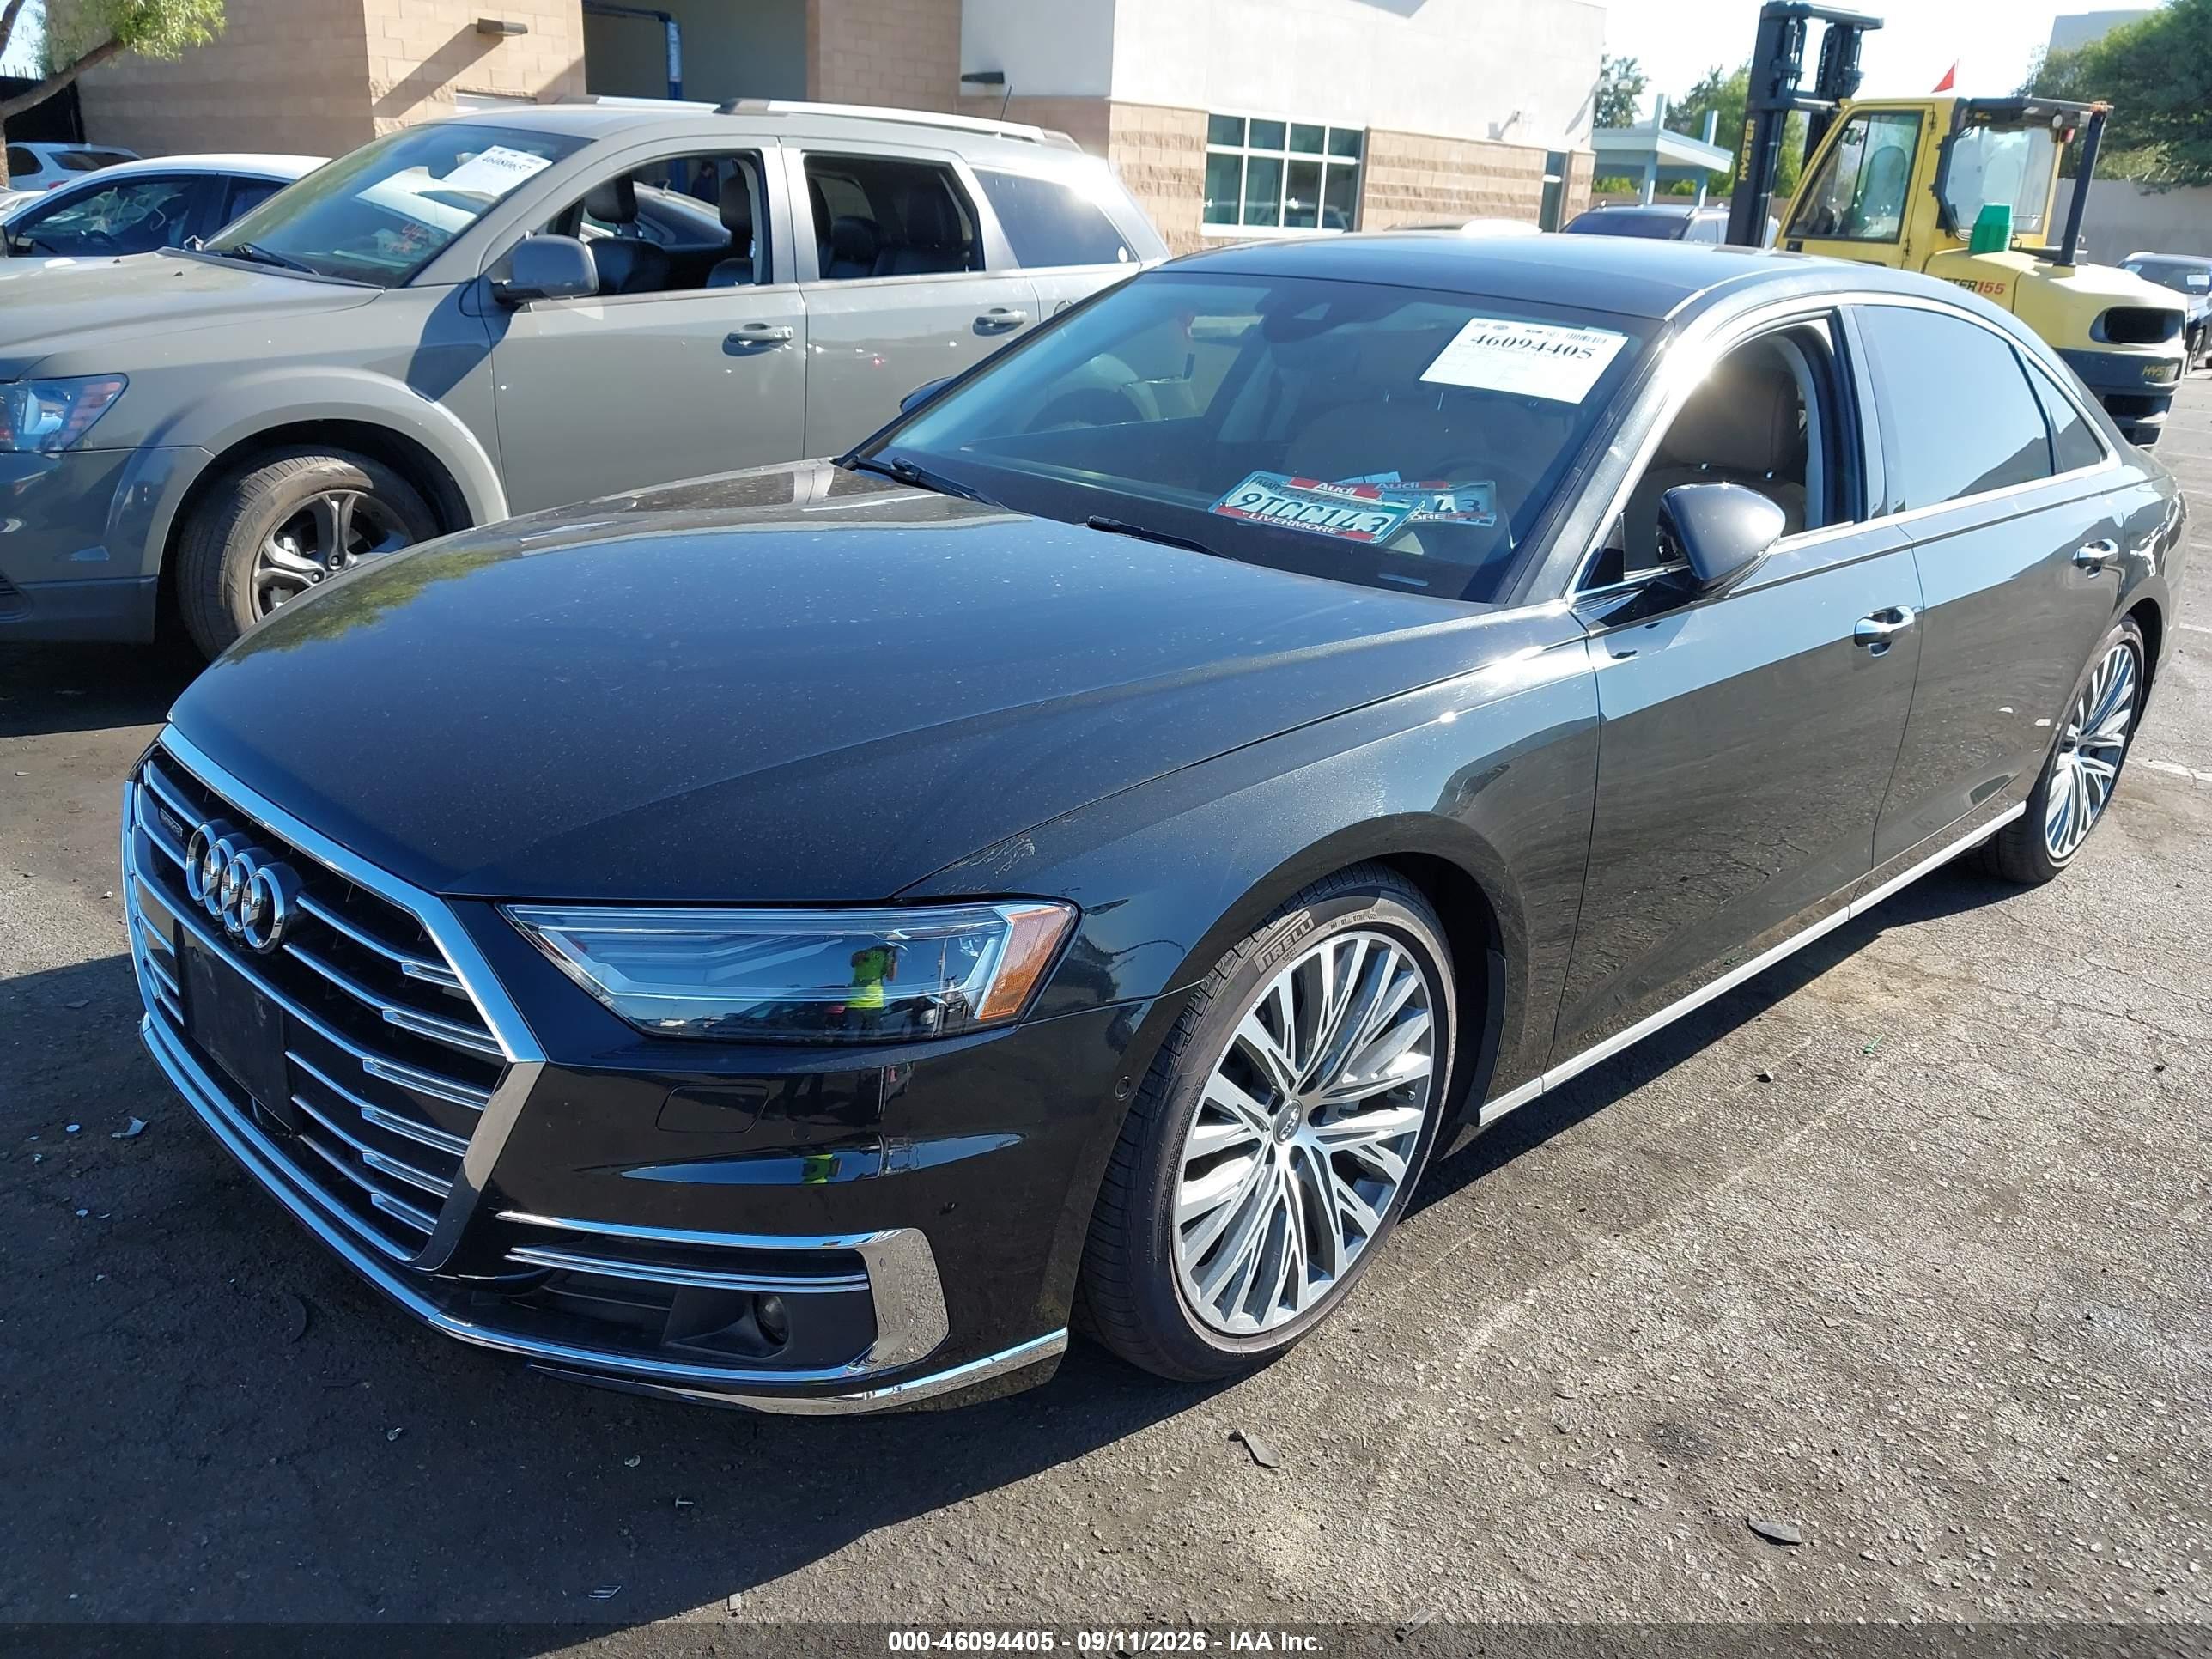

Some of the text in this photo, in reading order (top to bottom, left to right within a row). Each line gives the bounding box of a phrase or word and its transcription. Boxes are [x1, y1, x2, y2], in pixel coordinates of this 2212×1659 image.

[1738, 118, 1756, 181] HYSTER
[1469, 333, 1597, 360] 46094405
[1313, 482, 1358, 495] Audi
[1231, 492, 1389, 533] 9TCC143
[1248, 513, 1340, 535] LIVERMORE
[1252, 908, 1316, 975] PIRELLI
